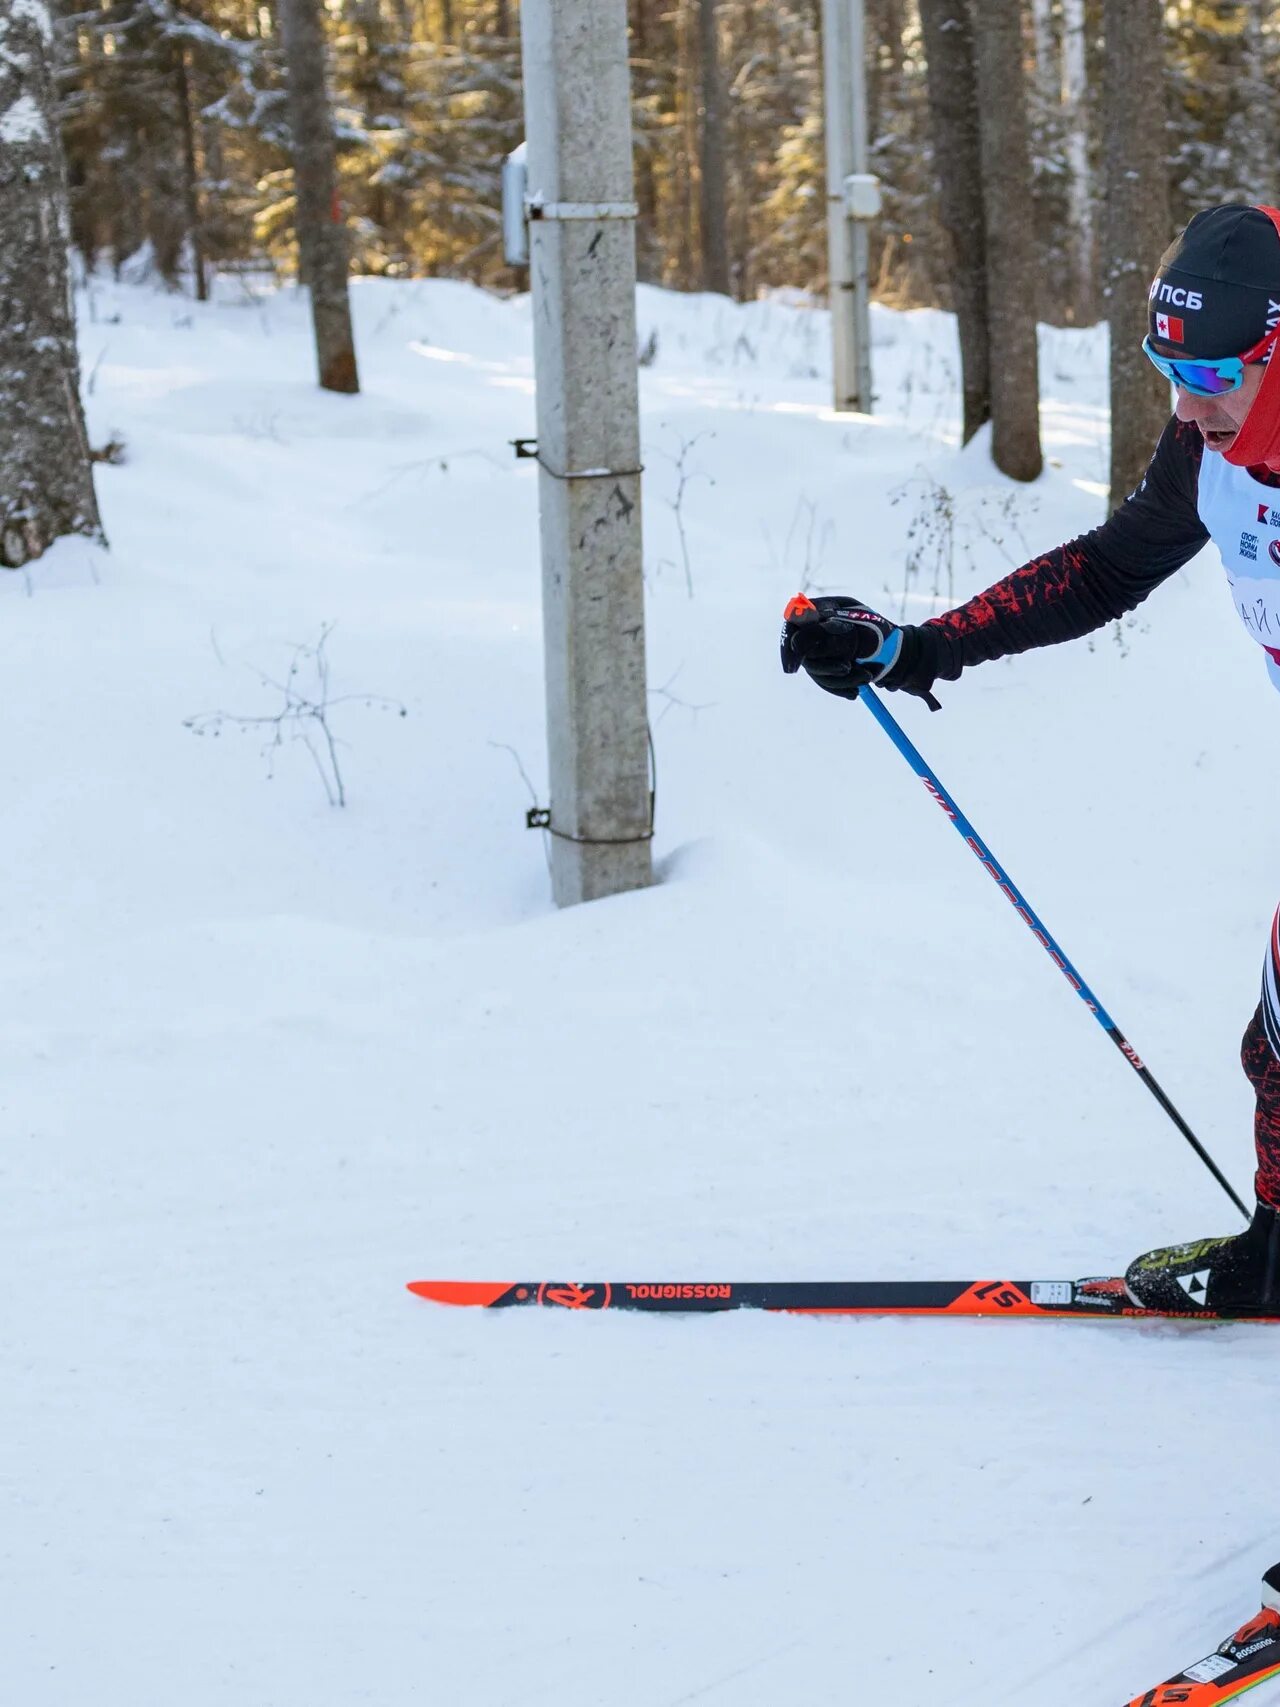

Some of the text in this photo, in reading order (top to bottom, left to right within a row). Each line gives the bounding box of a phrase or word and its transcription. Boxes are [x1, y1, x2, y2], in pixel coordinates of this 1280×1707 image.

[1159, 284, 1203, 310] ПСБ
[625, 1284, 732, 1299] ROSSIGNOL
[1235, 1638, 1276, 1661] ROSSIGNOL
